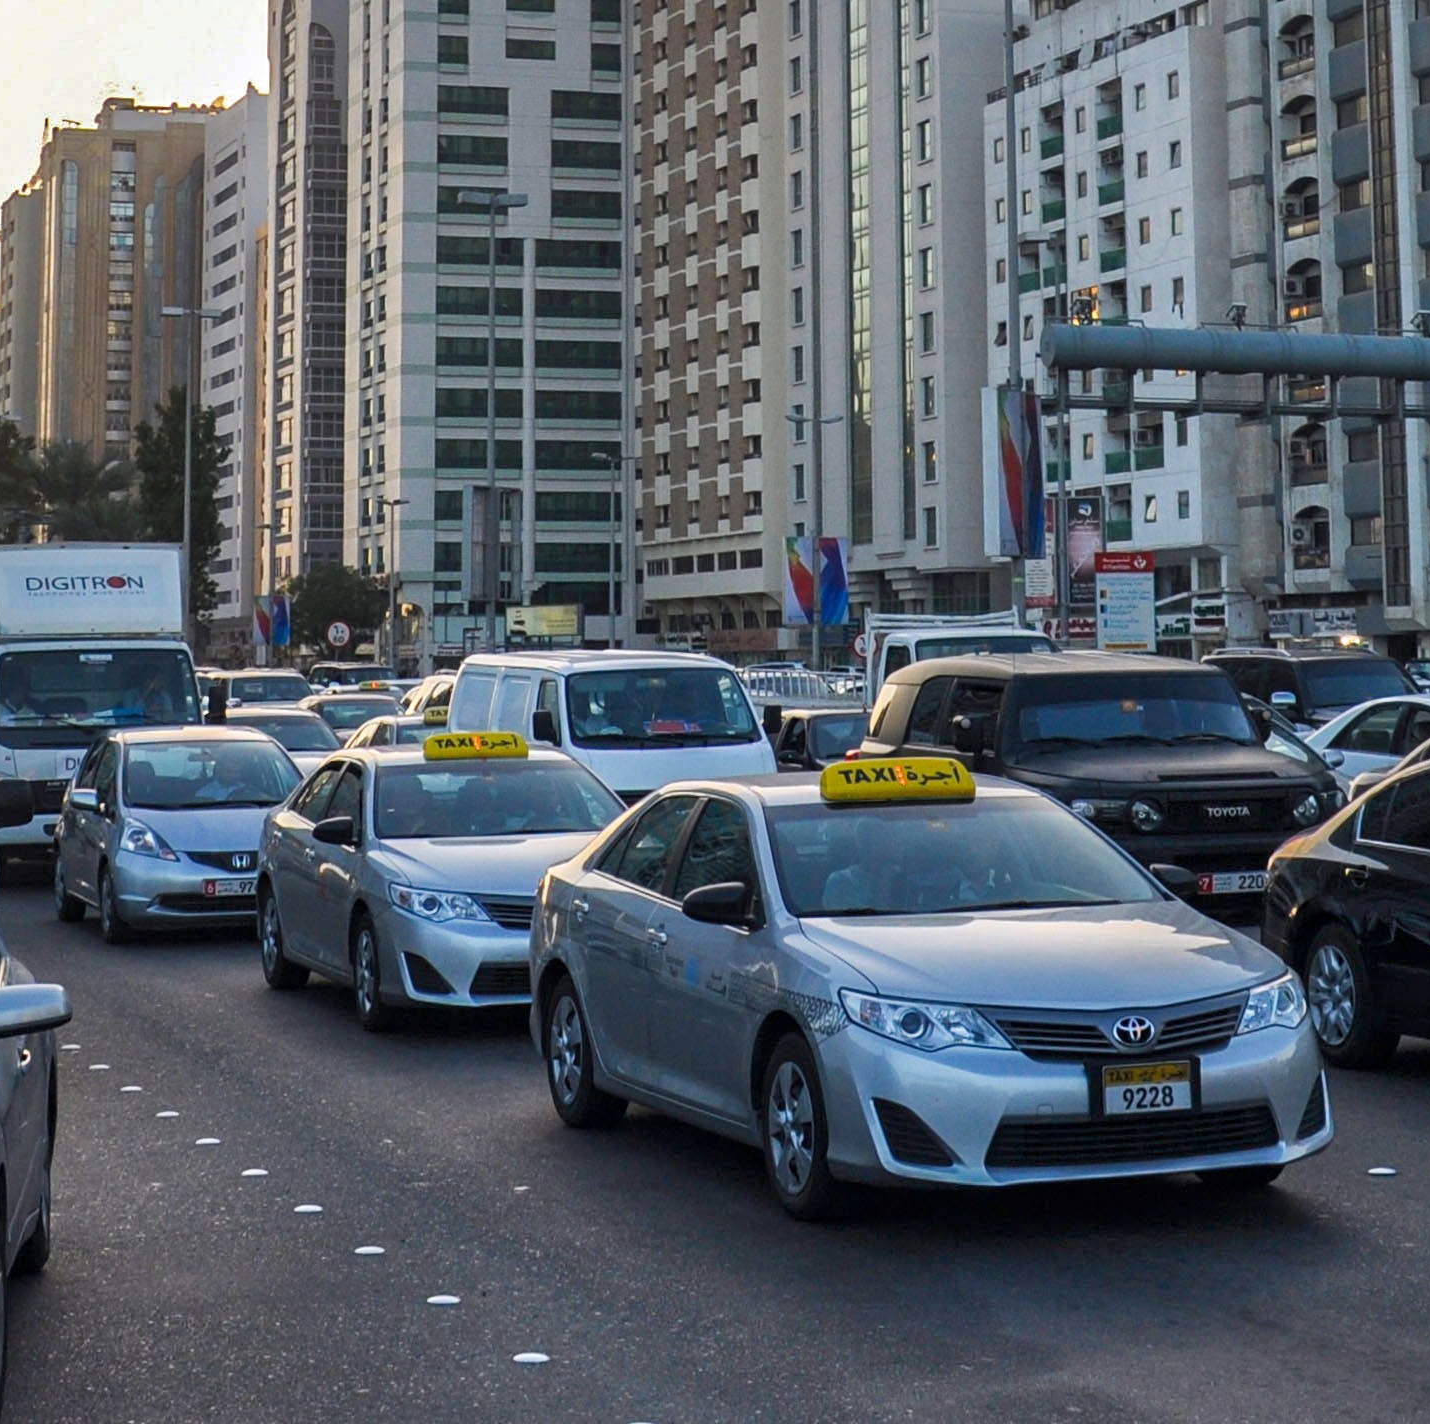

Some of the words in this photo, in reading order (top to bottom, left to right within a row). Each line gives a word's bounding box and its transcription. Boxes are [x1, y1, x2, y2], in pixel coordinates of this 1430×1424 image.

[25, 574, 145, 591] DIGITRON
[435, 738, 474, 749] TAXI
[837, 766, 898, 785] TAXI
[904, 761, 960, 786] أجرة
[1206, 806, 1250, 817] TOYOTA
[239, 881, 254, 893] 97
[1201, 878, 1209, 890] 7
[1238, 874, 1264, 889] 220
[1123, 1085, 1174, 1109] 9228
